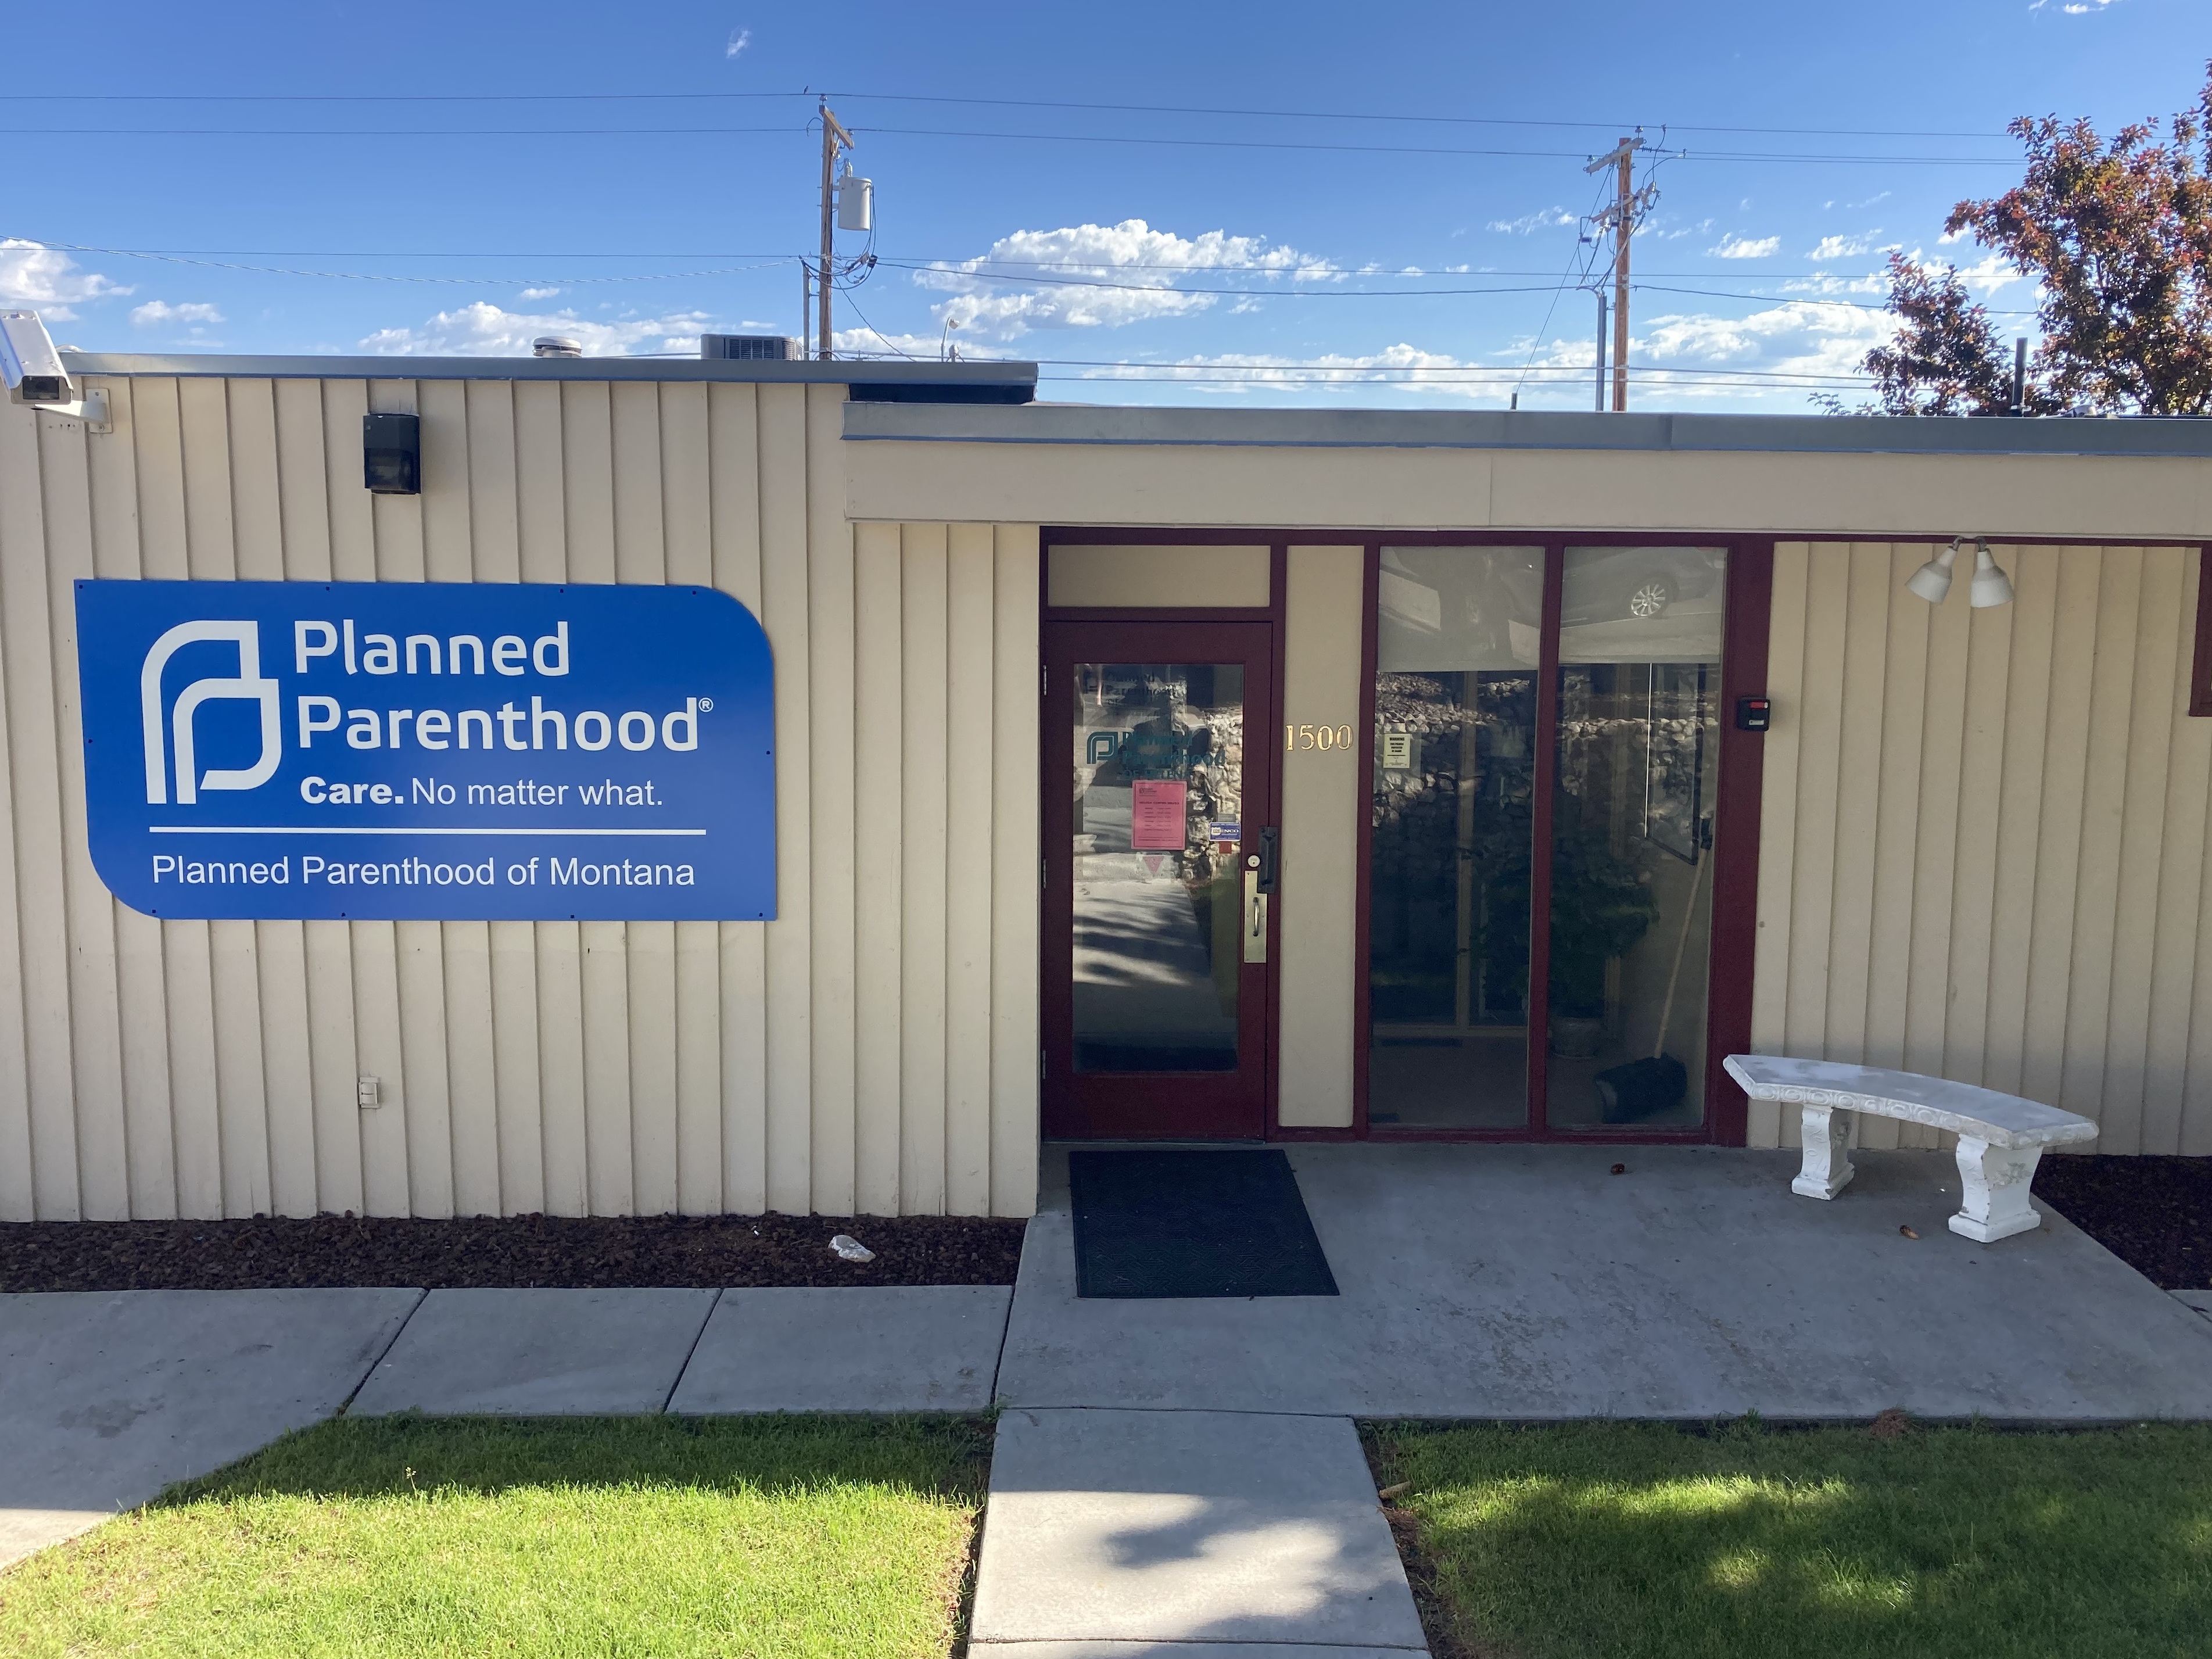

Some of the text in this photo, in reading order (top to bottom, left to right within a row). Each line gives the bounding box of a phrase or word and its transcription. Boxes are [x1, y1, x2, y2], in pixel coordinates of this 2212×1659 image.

[295, 619, 569, 676] Planned
[1286, 724, 1353, 751] 1500
[1122, 749, 1225, 765] Panthood
[300, 776, 662, 806] Care. No matter what.
[153, 855, 695, 886] Planned Parenthood of Montana
